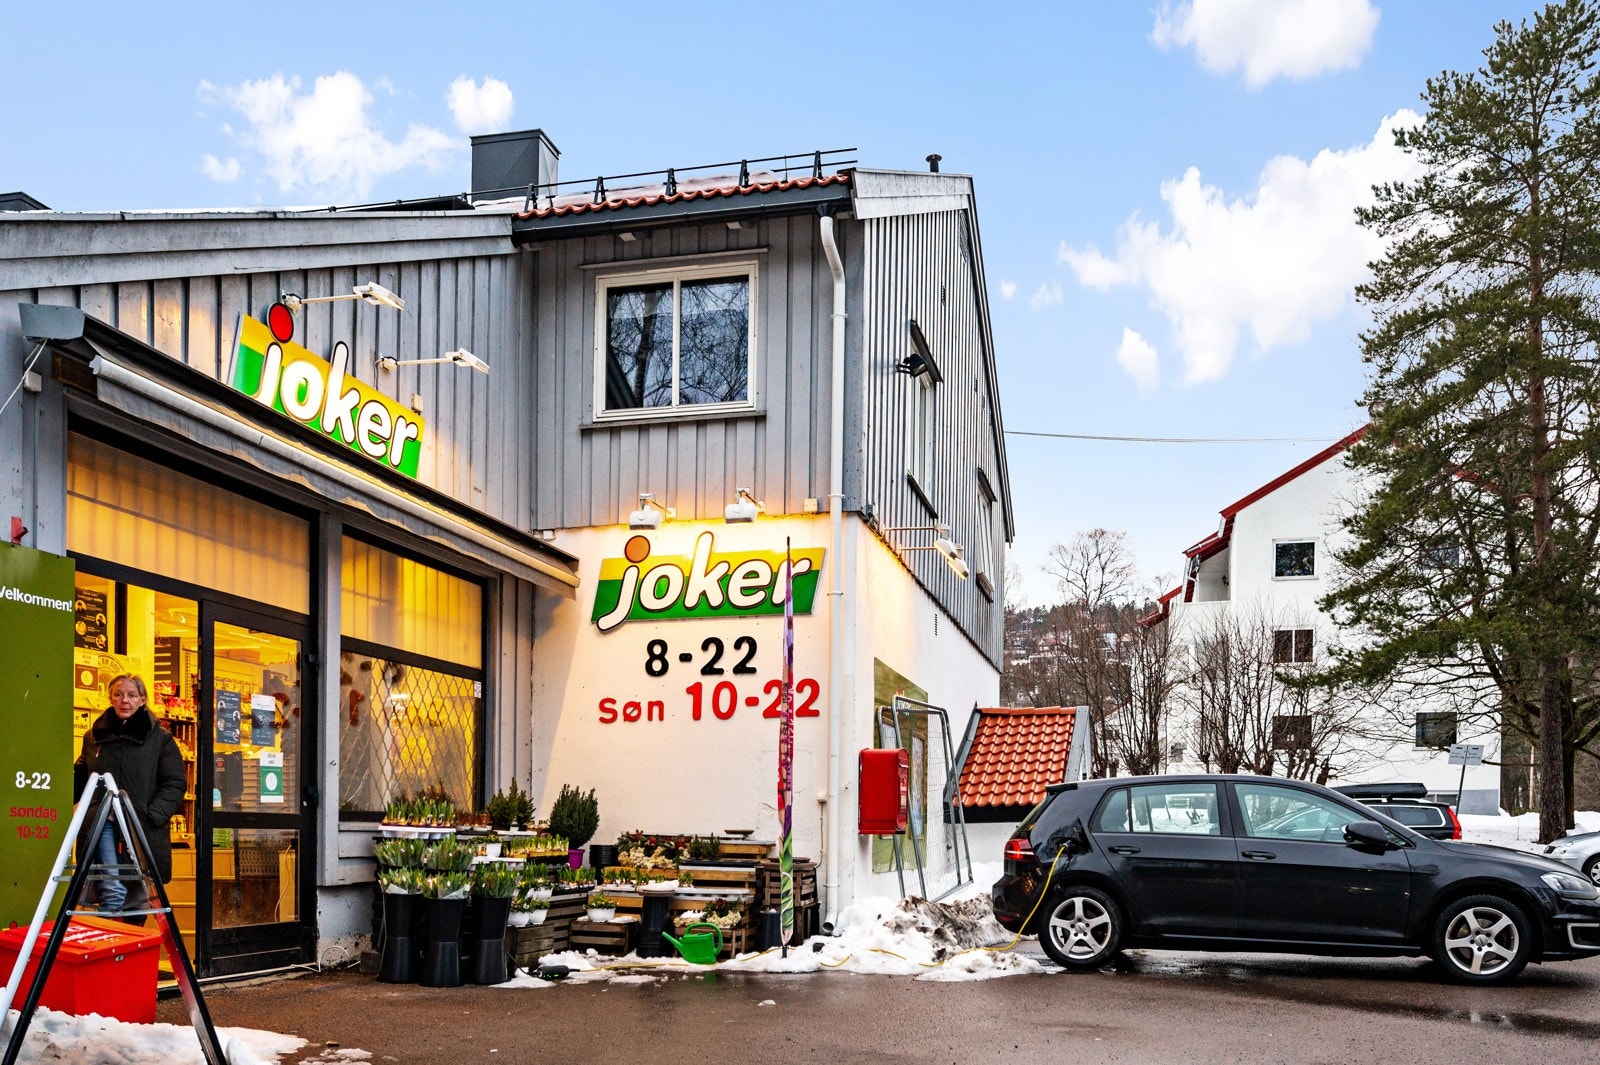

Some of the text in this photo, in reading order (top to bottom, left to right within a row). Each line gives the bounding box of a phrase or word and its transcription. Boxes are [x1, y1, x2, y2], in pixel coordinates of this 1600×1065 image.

[250, 302, 419, 468] joker
[597, 531, 812, 632] joker
[645, 635, 758, 677] 8-22
[686, 678, 821, 721] 10-22
[15, 770, 51, 790] 8-22
[9, 806, 58, 822] søndag
[17, 825, 50, 840] 10-22
